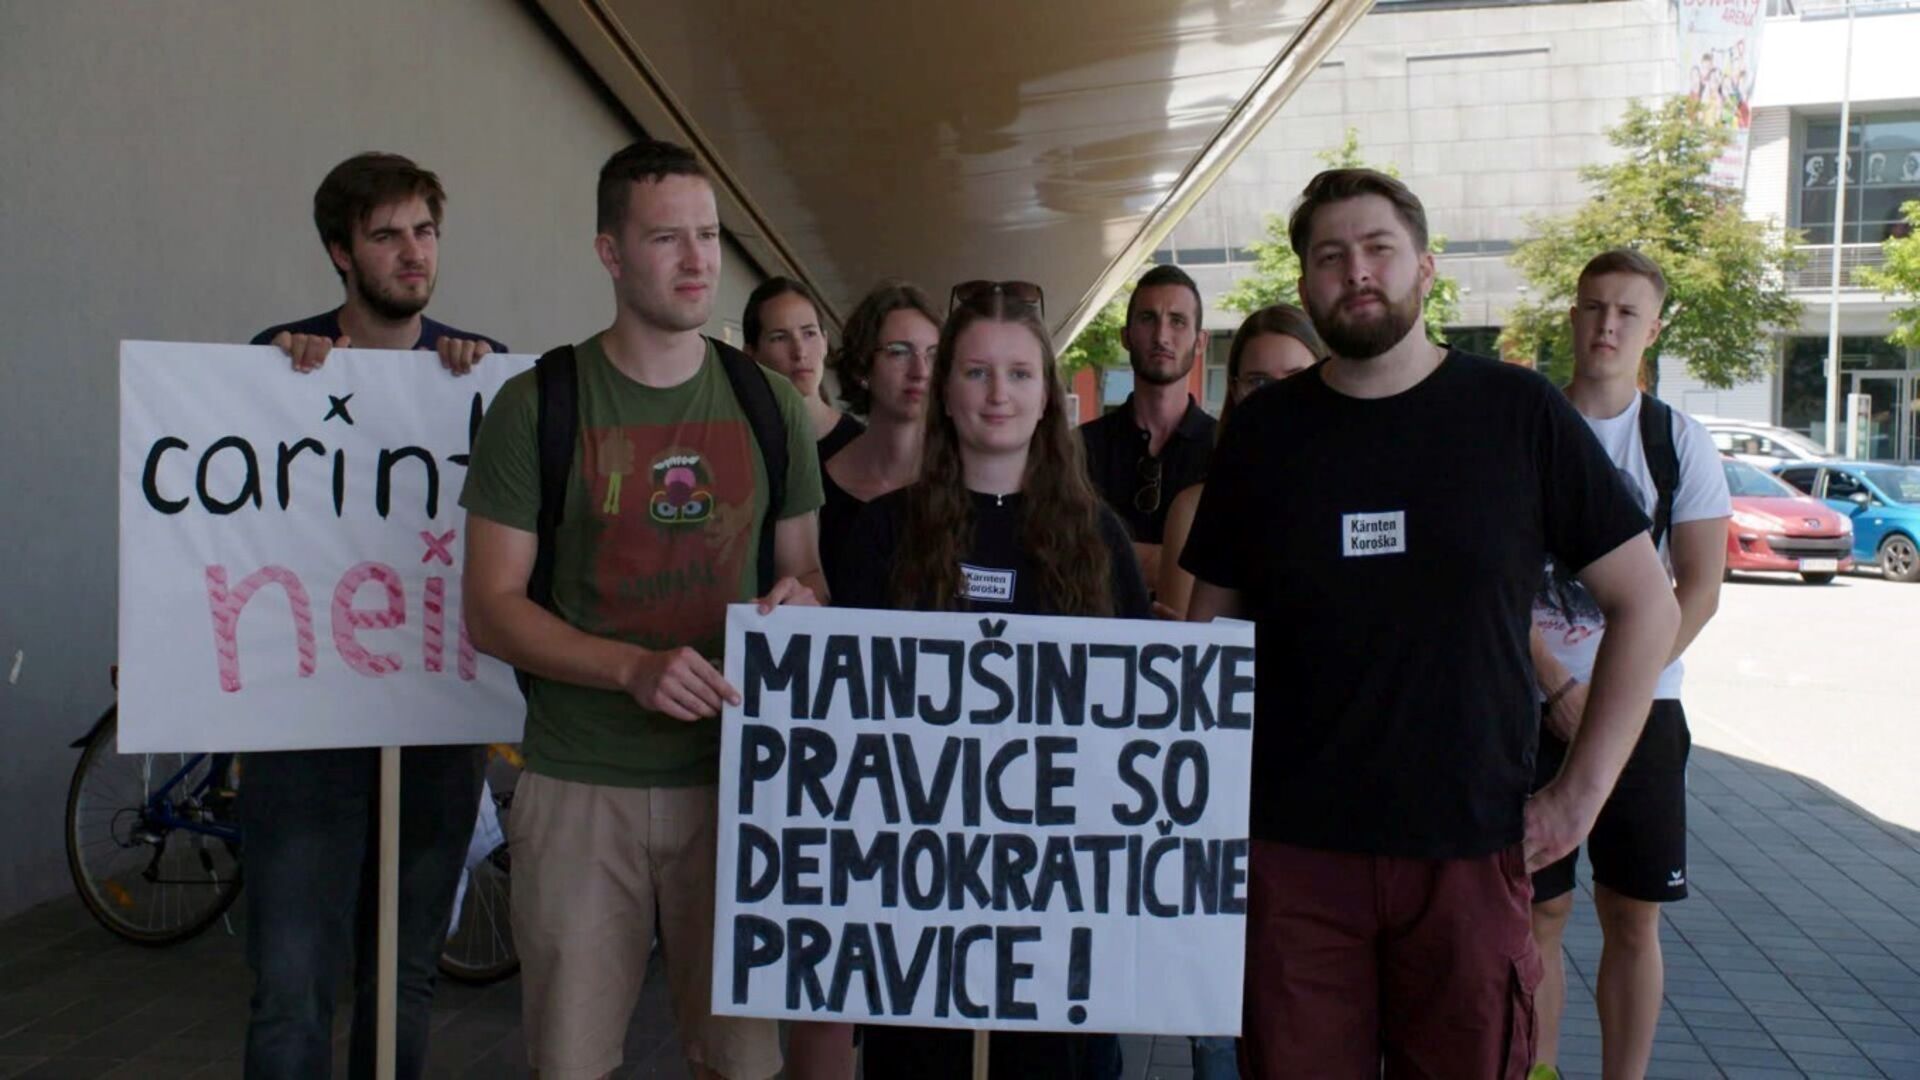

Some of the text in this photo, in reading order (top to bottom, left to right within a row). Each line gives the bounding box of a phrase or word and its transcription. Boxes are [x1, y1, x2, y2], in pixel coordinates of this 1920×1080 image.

[1351, 519, 1397, 533] Kärnten
[1351, 534, 1397, 550] Koroška
[205, 529, 479, 693] nei
[966, 583, 1006, 595] oroška
[743, 618, 1255, 732] MANJŠINJSKE
[738, 725, 1210, 827] PRAVICE SO
[735, 820, 1250, 917] DEMOKRATIČNE
[732, 914, 1042, 1021] PRAVICE
